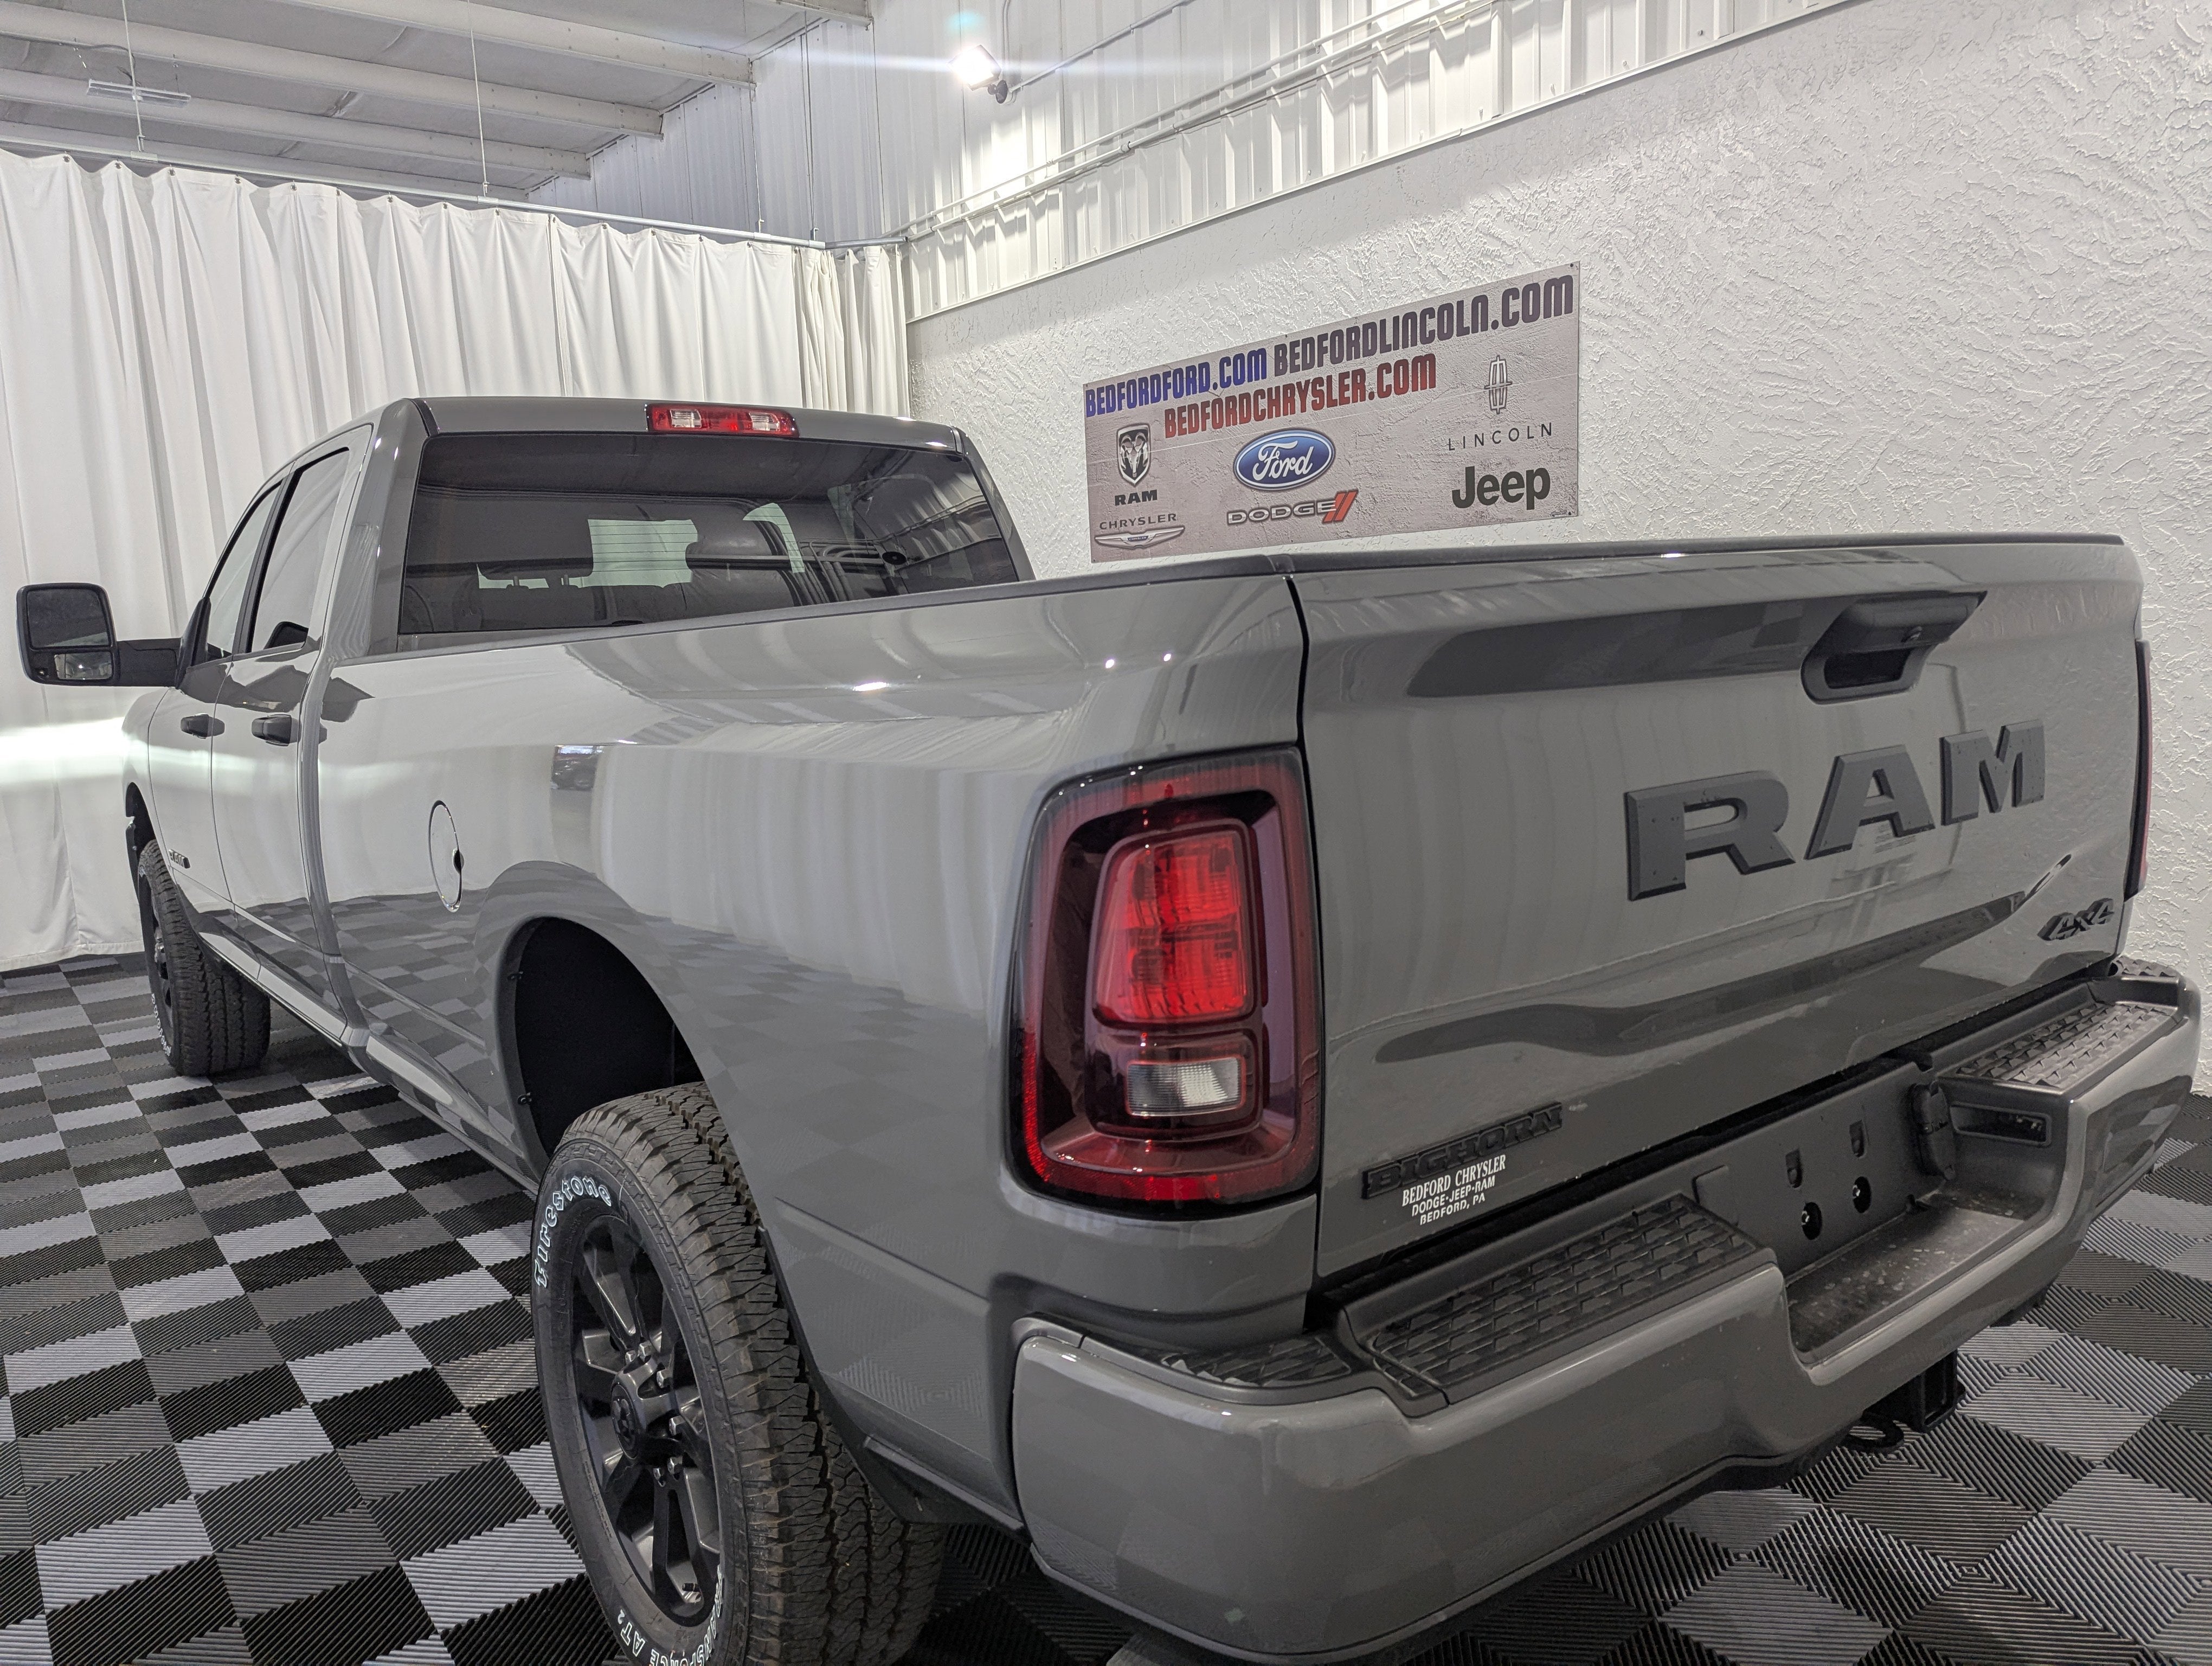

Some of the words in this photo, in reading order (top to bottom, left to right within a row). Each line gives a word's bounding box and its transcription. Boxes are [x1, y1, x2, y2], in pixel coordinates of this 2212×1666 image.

[1086, 348, 1267, 418] BEDFORDFORD.COM
[1274, 274, 1573, 376] BEDFORDLINCOLN.COM
[1165, 353, 1436, 438] BEDFORDCHRYSLER.COM
[1448, 422, 1552, 451] LINCOLN
[1252, 440, 1314, 481] Ford
[1114, 489, 1158, 506] RAM
[1452, 466, 1551, 510] Jeep
[1099, 513, 1177, 530] CHRYSLER
[1227, 500, 1336, 524] DODGE
[1623, 719, 2046, 902] RAM
[1402, 1175, 1451, 1207] BEDFORD
[1455, 1155, 1506, 1185] CHRYSLER
[1420, 1200, 1470, 1226] BEDFORD,
[1472, 1193, 1486, 1206] PA
[535, 1176, 612, 1288] Firestone
